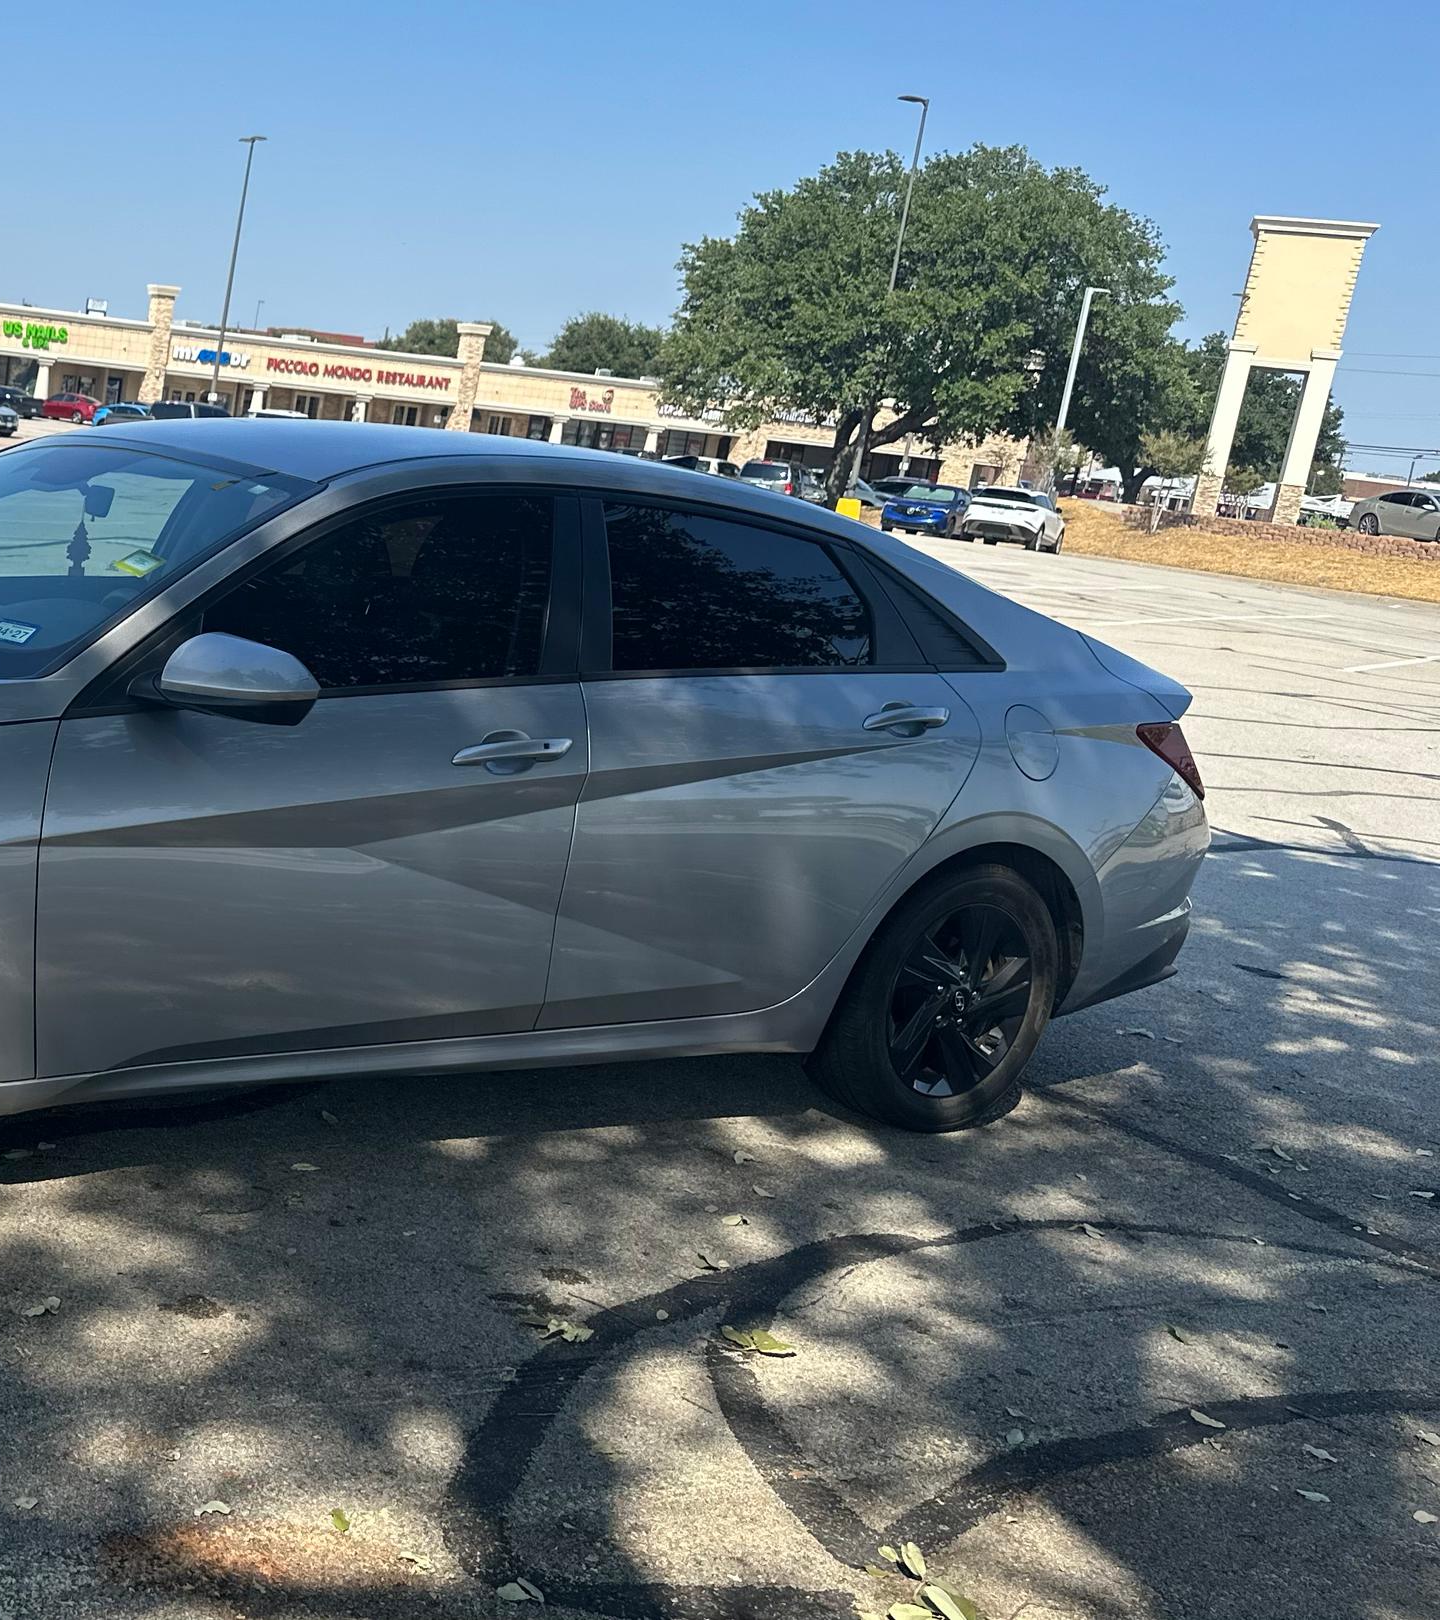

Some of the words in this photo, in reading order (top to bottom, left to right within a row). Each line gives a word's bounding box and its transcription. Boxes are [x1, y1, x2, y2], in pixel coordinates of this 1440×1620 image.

[3, 321, 23, 337] US
[26, 323, 68, 343] NAILS
[267, 357, 320, 377] PICCOLO
[323, 364, 373, 383] MONDO
[376, 370, 452, 391] RESTAURANT
[11, 630, 29, 639] 27
